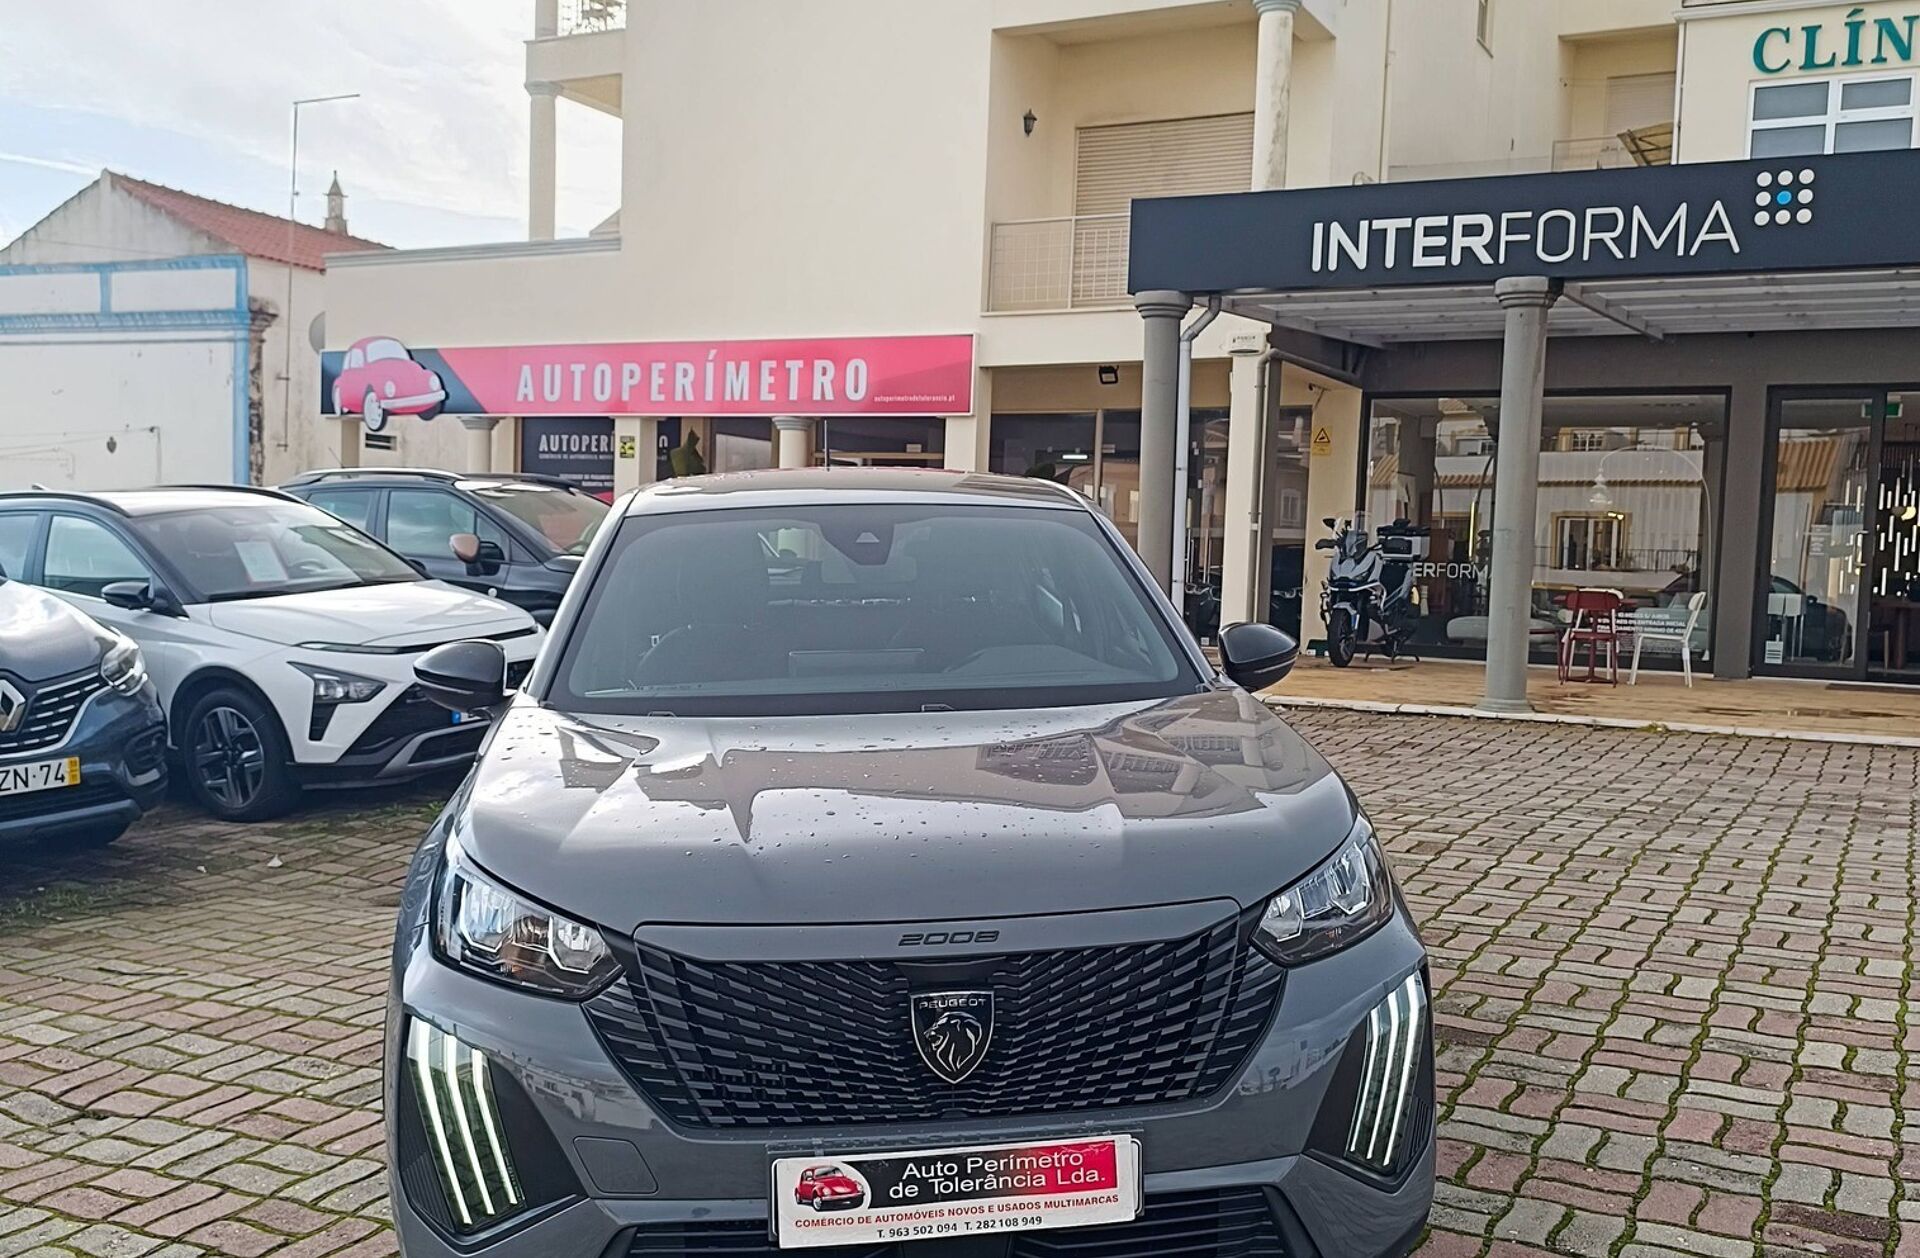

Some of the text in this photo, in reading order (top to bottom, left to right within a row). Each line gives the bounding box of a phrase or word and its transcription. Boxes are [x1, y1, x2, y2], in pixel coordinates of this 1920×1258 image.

[1753, 8, 1920, 74] CLÍN
[1311, 200, 1740, 272] INTERFORMA
[516, 349, 869, 402] AUTOPERÍMETRO
[898, 930, 1000, 946] 2008
[919, 998, 987, 1010] PEUGEOT
[902, 1152, 1083, 1180] Auto Perímetro
[889, 1167, 1106, 1199] de Tolerância Lda.
[857, 1216, 872, 1225] DE
[875, 1208, 945, 1224] AUTOMÓVEIS
[947, 1205, 985, 1217] NOVOS
[988, 1204, 994, 1213] E
[997, 1199, 1042, 1213] USADOS
[1044, 1194, 1119, 1209] MULTIMARCAS
[877, 1216, 1043, 1239] T. 963 502 094 T. 282 108 949
